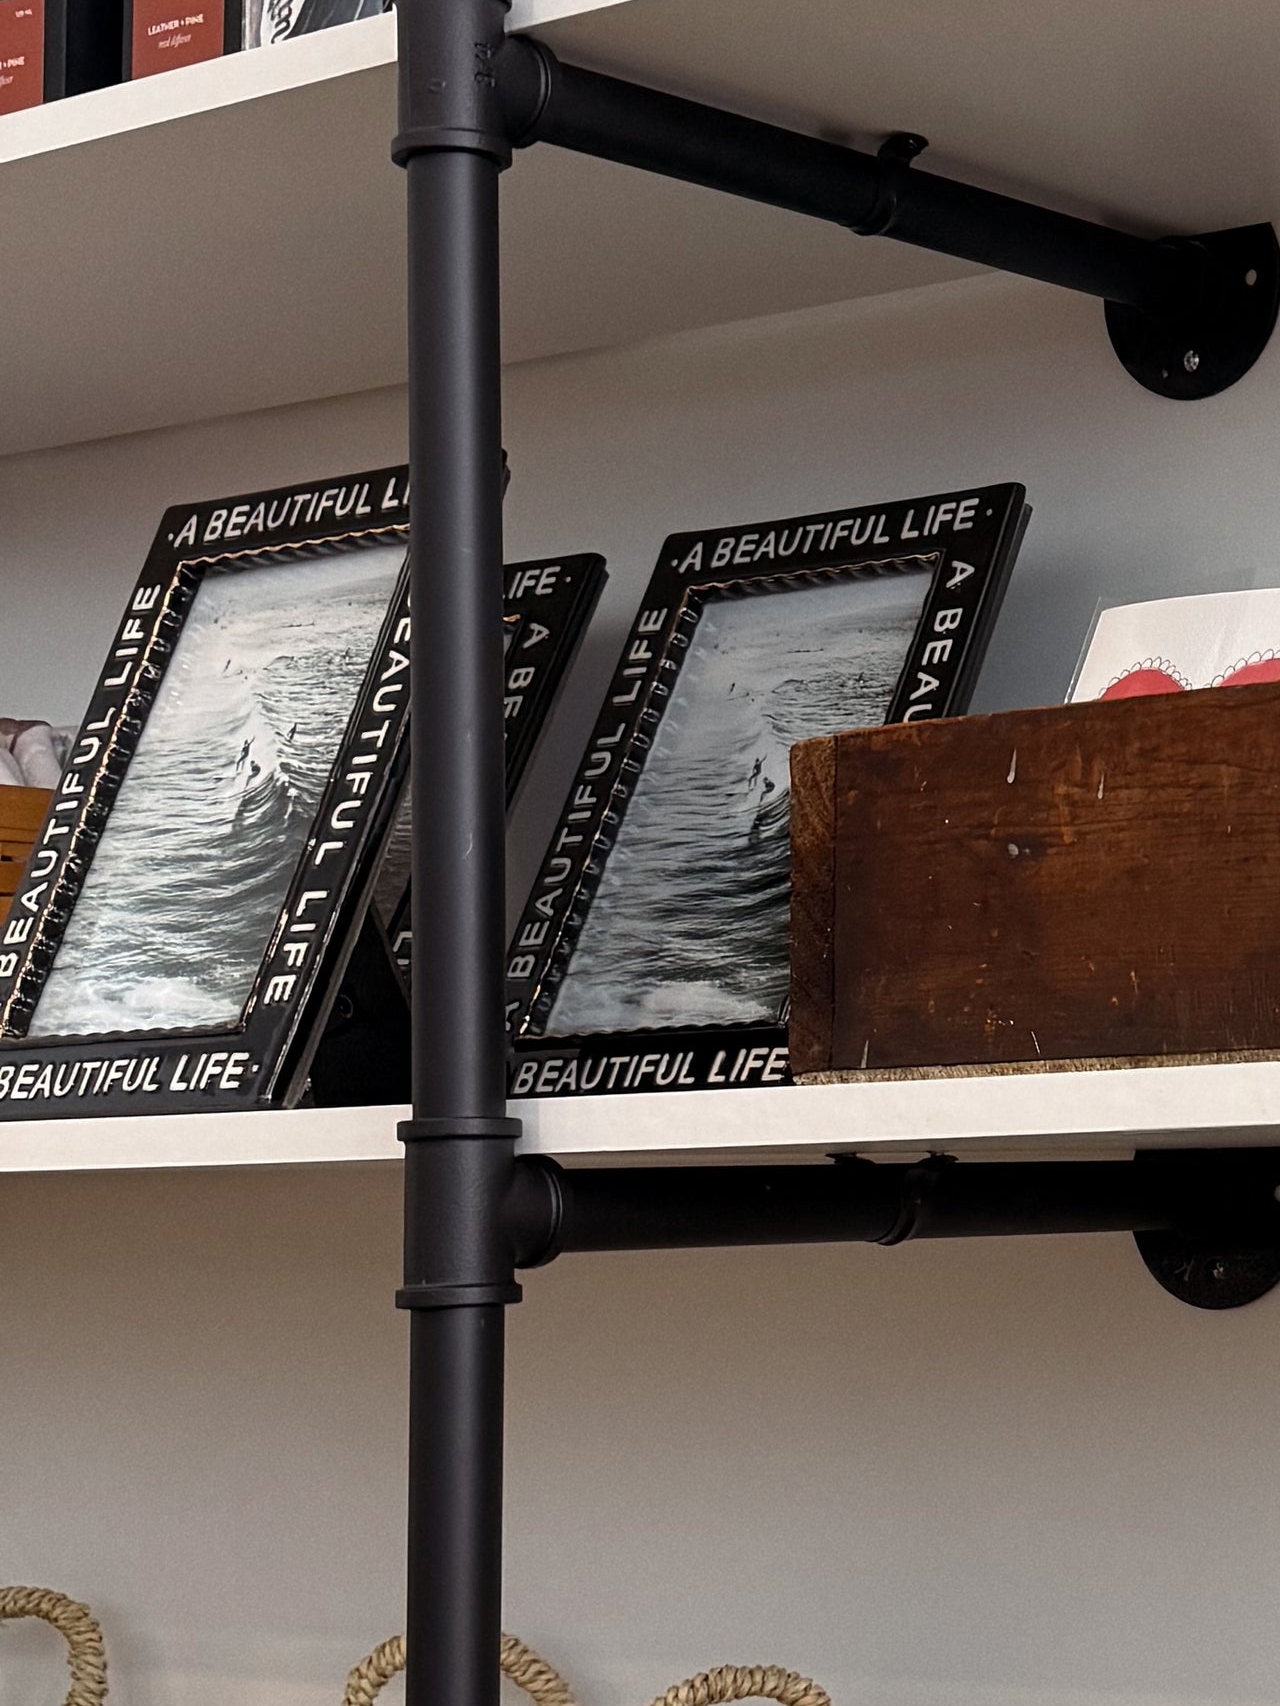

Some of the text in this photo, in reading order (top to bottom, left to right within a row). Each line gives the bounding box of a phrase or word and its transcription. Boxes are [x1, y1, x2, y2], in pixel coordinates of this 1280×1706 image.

[148, 19, 179, 36] LEATHER
[185, 14, 204, 26] PINE
[7, 56, 25, 68] PINE
[173, 514, 197, 548] A
[204, 483, 372, 543] BEAUTIFUL
[679, 497, 980, 574] A BEAUTIFUL LIFE
[502, 565, 561, 600] IFE
[945, 559, 975, 590] A
[105, 583, 161, 687] LIFE
[523, 622, 550, 648] A
[263, 595, 411, 1005] EAUTIFUL LIFE
[507, 607, 668, 981] BEAUTIFUL LIFE
[169, 1051, 250, 1091] LIFE
[513, 1047, 789, 1094] BEAUTIFUL LIFE
